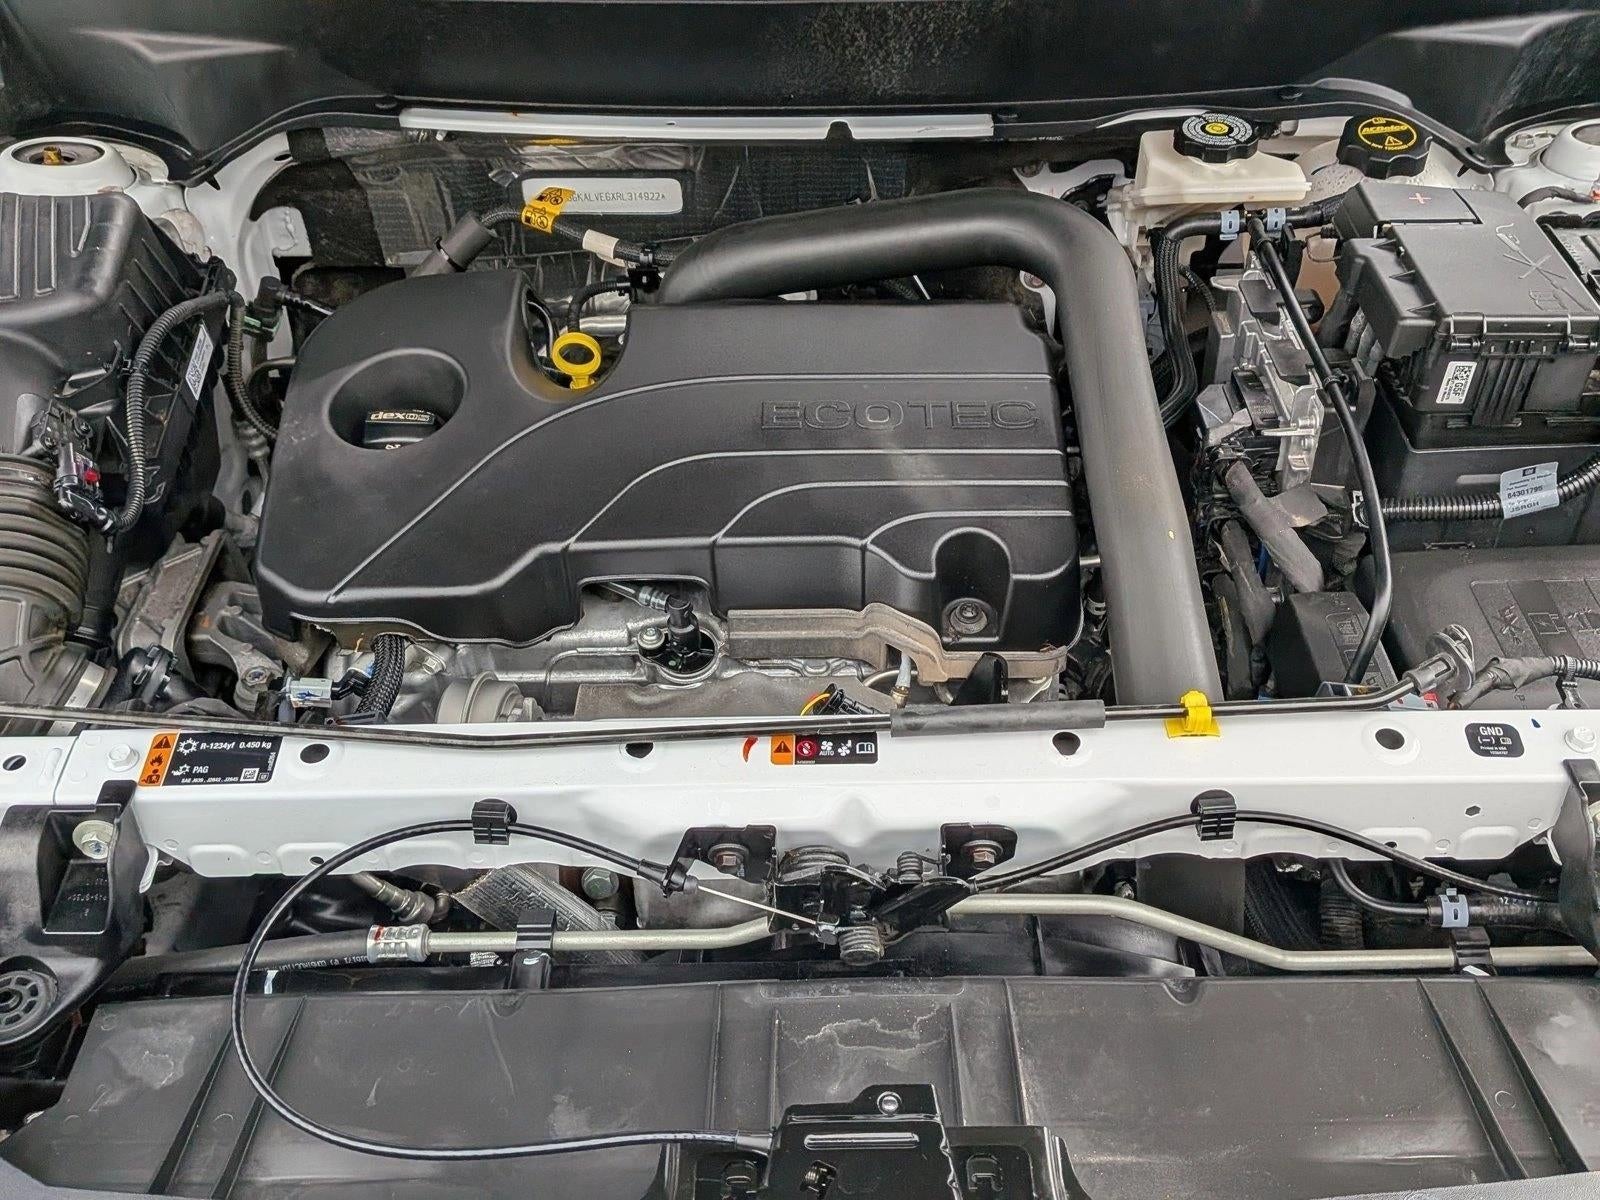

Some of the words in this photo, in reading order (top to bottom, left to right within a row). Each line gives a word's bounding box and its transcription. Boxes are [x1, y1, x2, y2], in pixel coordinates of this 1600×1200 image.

[370, 411, 430, 422] dexos
[761, 399, 1039, 430] ECOTEC
[1479, 726, 1504, 736] GND
[200, 741, 235, 751] R-1234yf
[261, 741, 272, 749] kg
[192, 765, 210, 774] PAG
